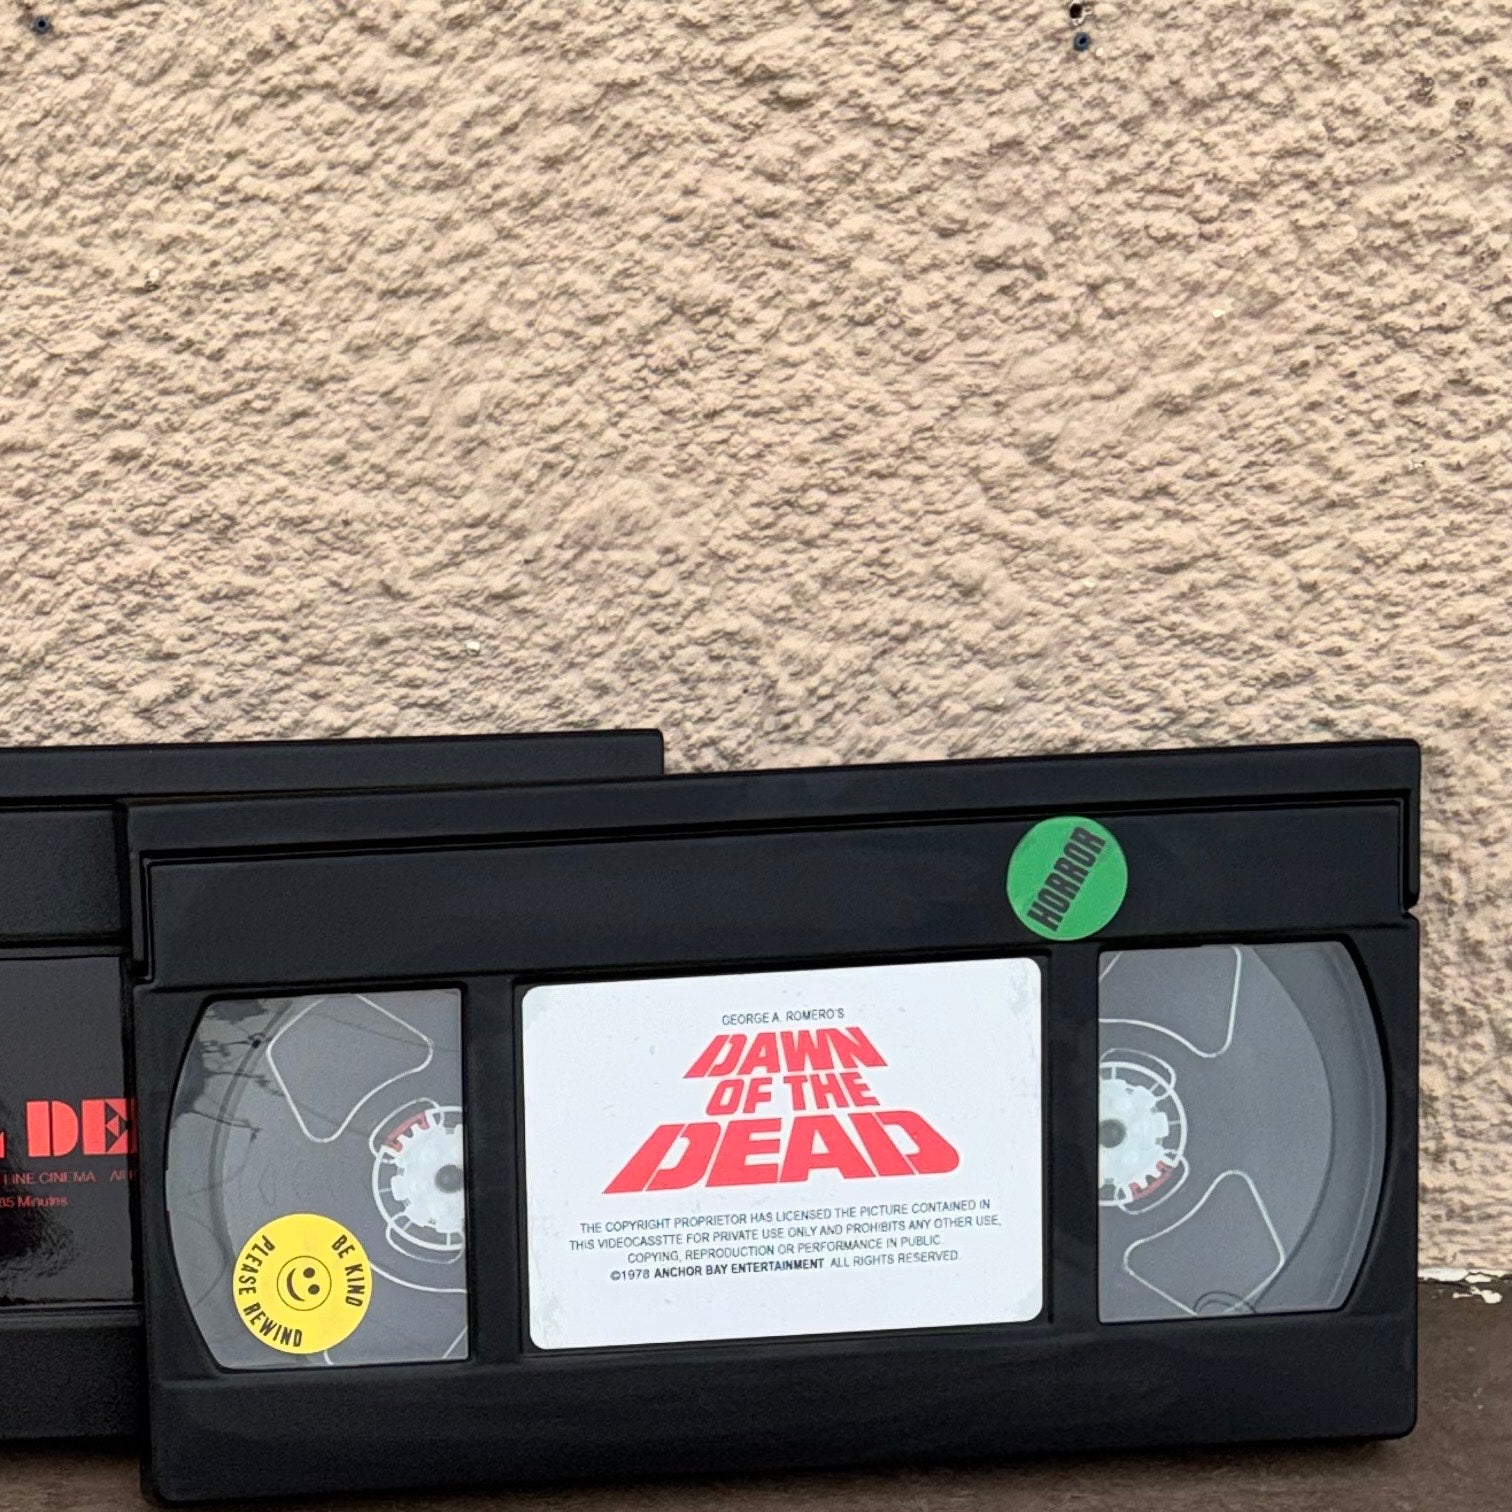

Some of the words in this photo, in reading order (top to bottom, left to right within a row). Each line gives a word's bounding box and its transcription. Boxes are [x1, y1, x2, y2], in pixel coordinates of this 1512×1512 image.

[1027, 826, 1106, 932] HORROR
[722, 1012, 769, 1025] GEORGE
[786, 1008, 844, 1021] ROMERO'S
[682, 1026, 889, 1079] DAWN
[705, 1077, 772, 1116] OF
[783, 1072, 882, 1111] THE
[26, 1097, 136, 1157] DE
[601, 1110, 961, 1194] DEAD
[570, 1239, 595, 1251] THIS
[598, 1234, 683, 1249] VIDEOCASSTTE
[686, 1232, 710, 1244] FOR
[713, 1229, 758, 1242] PRIVATE
[762, 1227, 785, 1239] USE
[788, 1226, 817, 1238] ONLY
[819, 1224, 842, 1236] AND
[846, 1220, 906, 1234] PROHIBITS
[909, 1218, 931, 1230] ANY
[934, 1216, 972, 1229] OTHER
[580, 1221, 602, 1234] THE
[605, 1218, 671, 1233] COPYRIGHT
[674, 1213, 747, 1228] PROPRIETOR
[751, 1211, 772, 1223] HAS
[776, 1208, 831, 1222] LICENSED
[835, 1206, 856, 1219] THE
[860, 1203, 908, 1217] PICTURE
[912, 1200, 976, 1214] CONTAINED
[980, 1199, 990, 1210] IN
[238, 1234, 275, 1295] PLEASE
[331, 1234, 356, 1259] BE
[344, 1263, 366, 1307] KIND
[654, 1265, 702, 1279] ANCHOR
[706, 1263, 728, 1275] BAY
[830, 1255, 850, 1268] ALL
[853, 1252, 894, 1266] RIGHTS
[685, 1244, 774, 1260] REPRODUCTION
[778, 1243, 795, 1255] OR
[797, 1238, 882, 1253] PERFORMANCE
[887, 1236, 897, 1248] IN
[243, 1302, 303, 1347] REWIND
